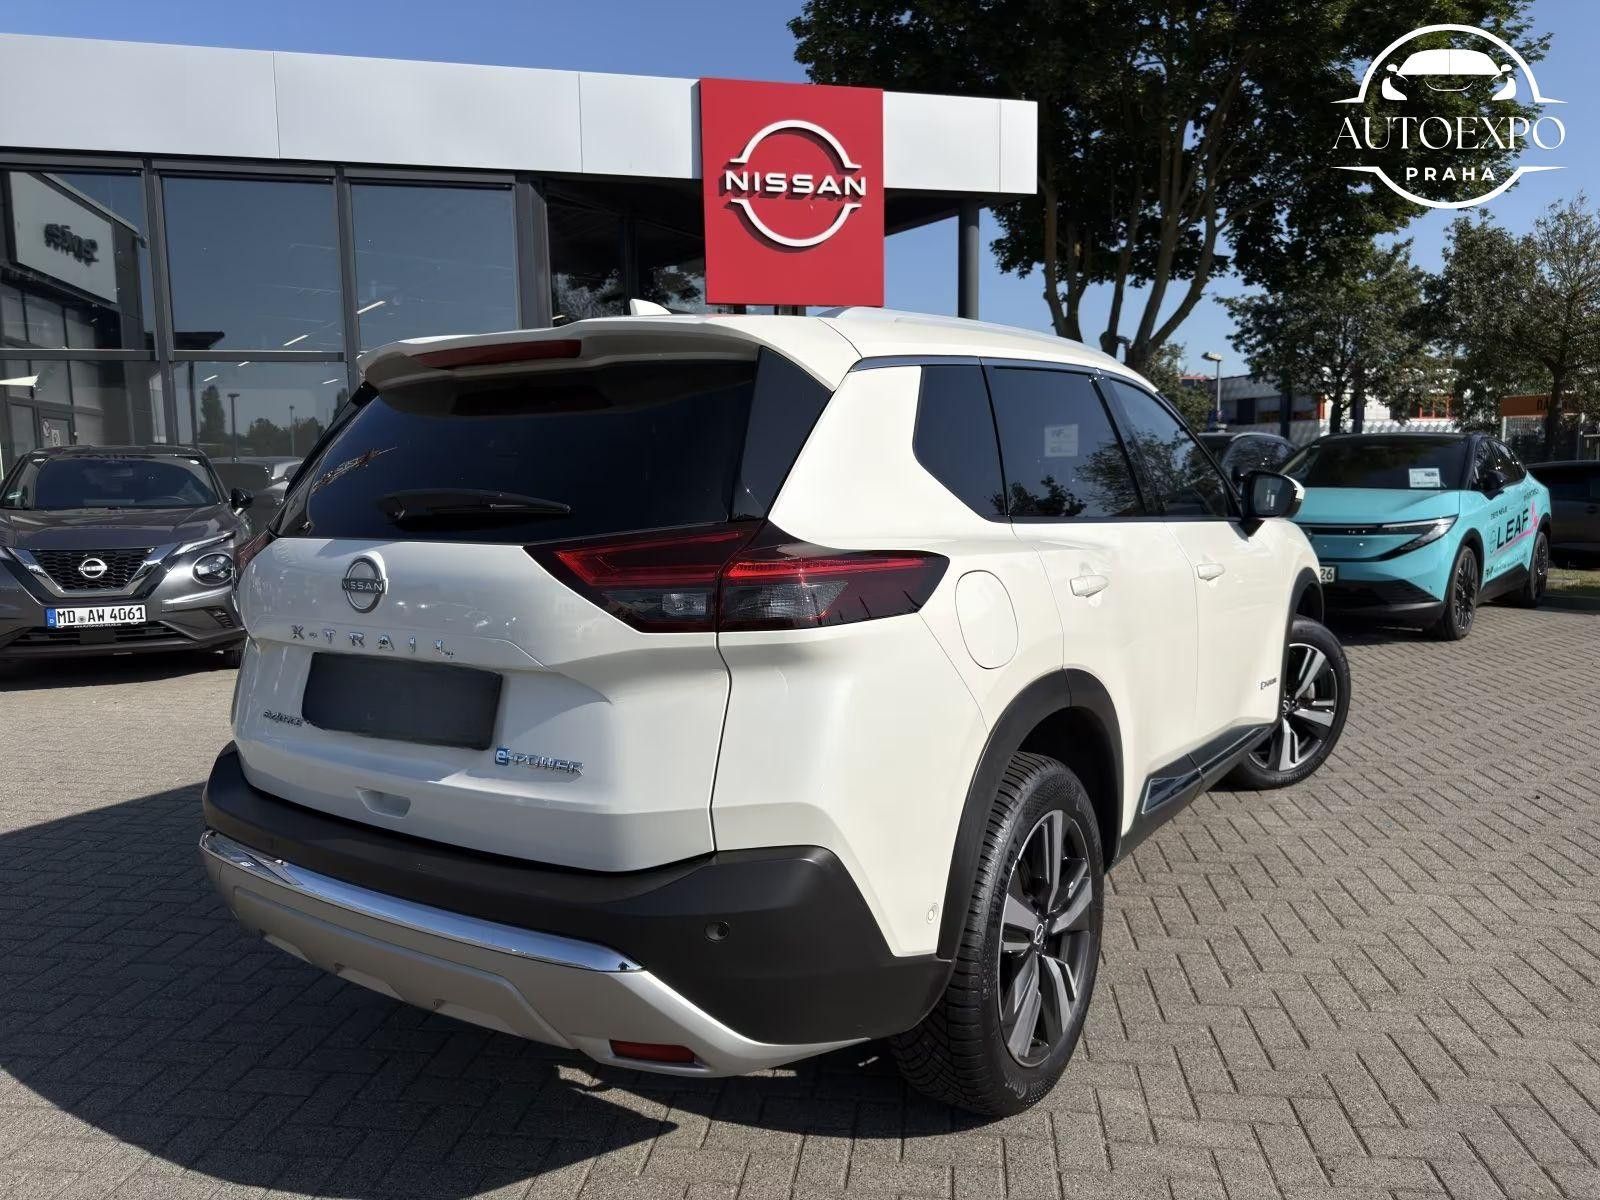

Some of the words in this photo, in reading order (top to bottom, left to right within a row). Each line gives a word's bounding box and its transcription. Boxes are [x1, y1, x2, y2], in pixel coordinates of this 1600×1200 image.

[725, 170, 866, 196] NISSAN
[1496, 508, 1529, 549] LEAF
[56, 610, 76, 624] MD
[87, 608, 105, 623] AW
[109, 606, 145, 621] 4061
[290, 624, 455, 658] X-TRAIL
